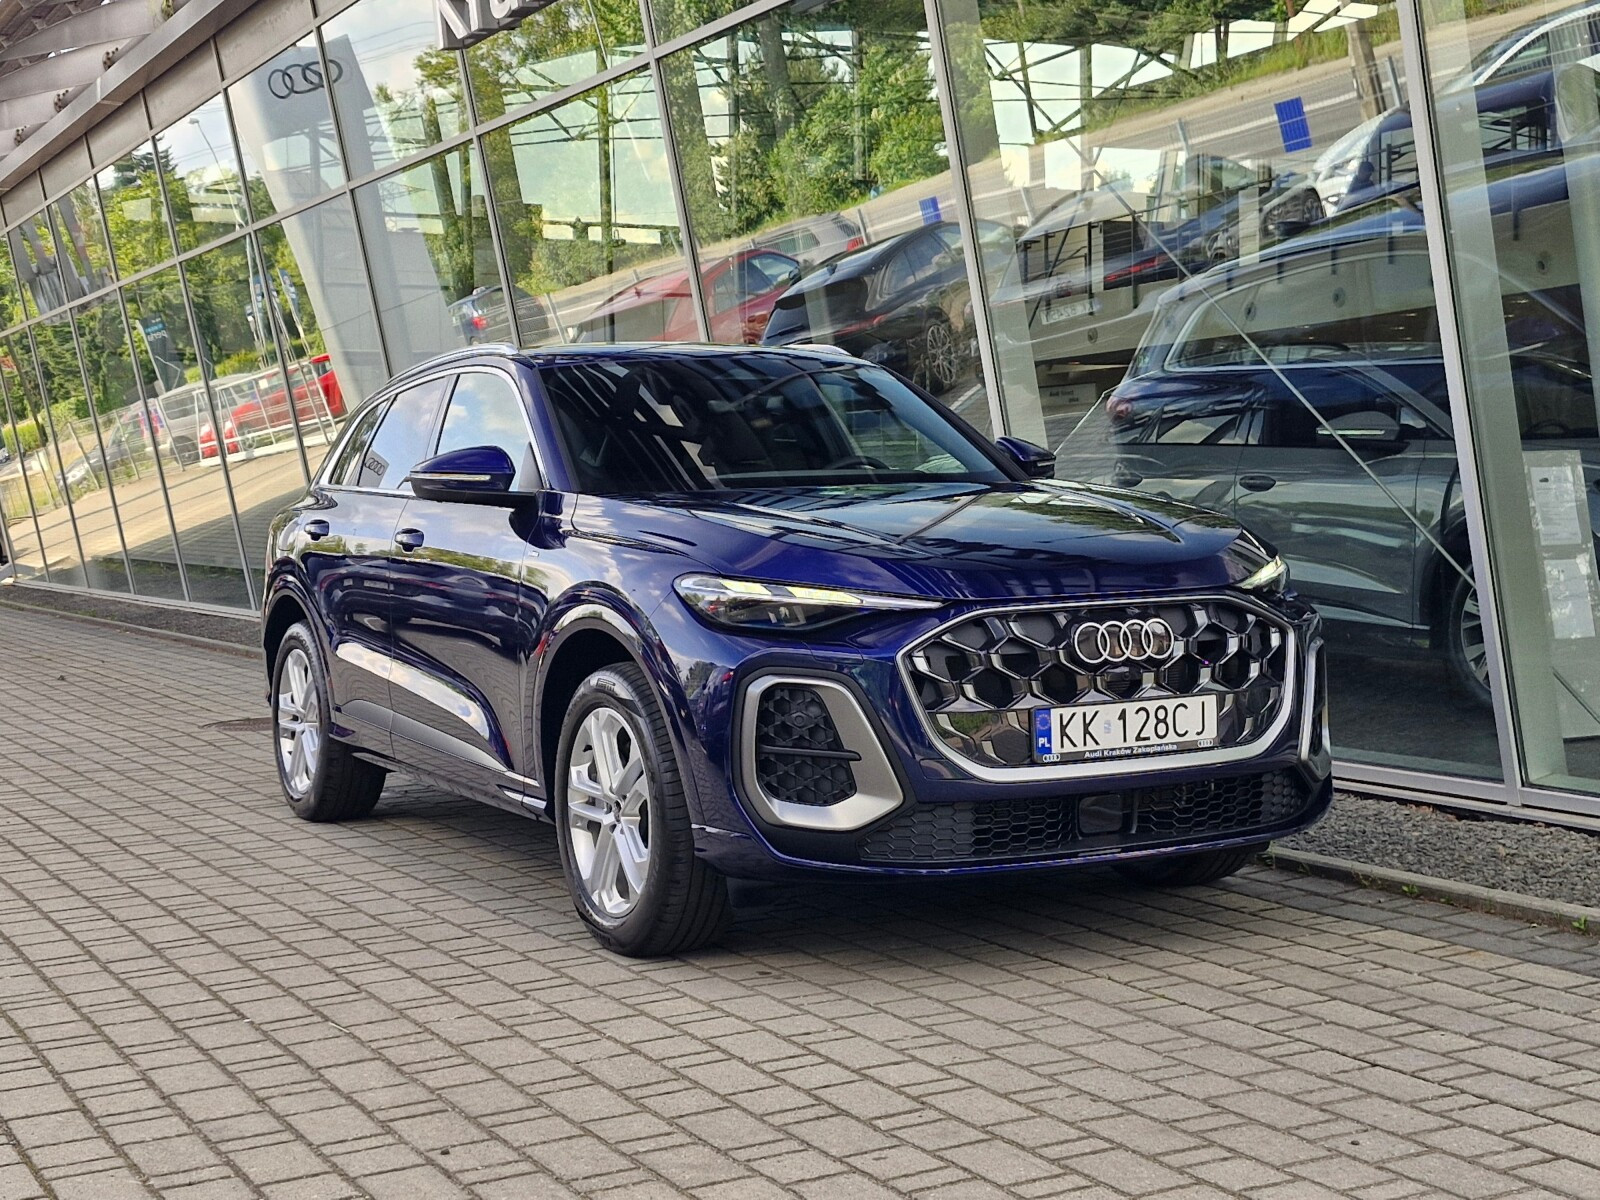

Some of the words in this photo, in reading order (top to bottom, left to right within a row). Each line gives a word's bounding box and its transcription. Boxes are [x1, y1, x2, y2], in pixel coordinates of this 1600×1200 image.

[1059, 709, 1100, 749] KK
[1117, 701, 1205, 743] 128CJ
[1038, 736, 1050, 748] PL
[1084, 751, 1102, 759] Audi
[1103, 748, 1132, 757] Kraków
